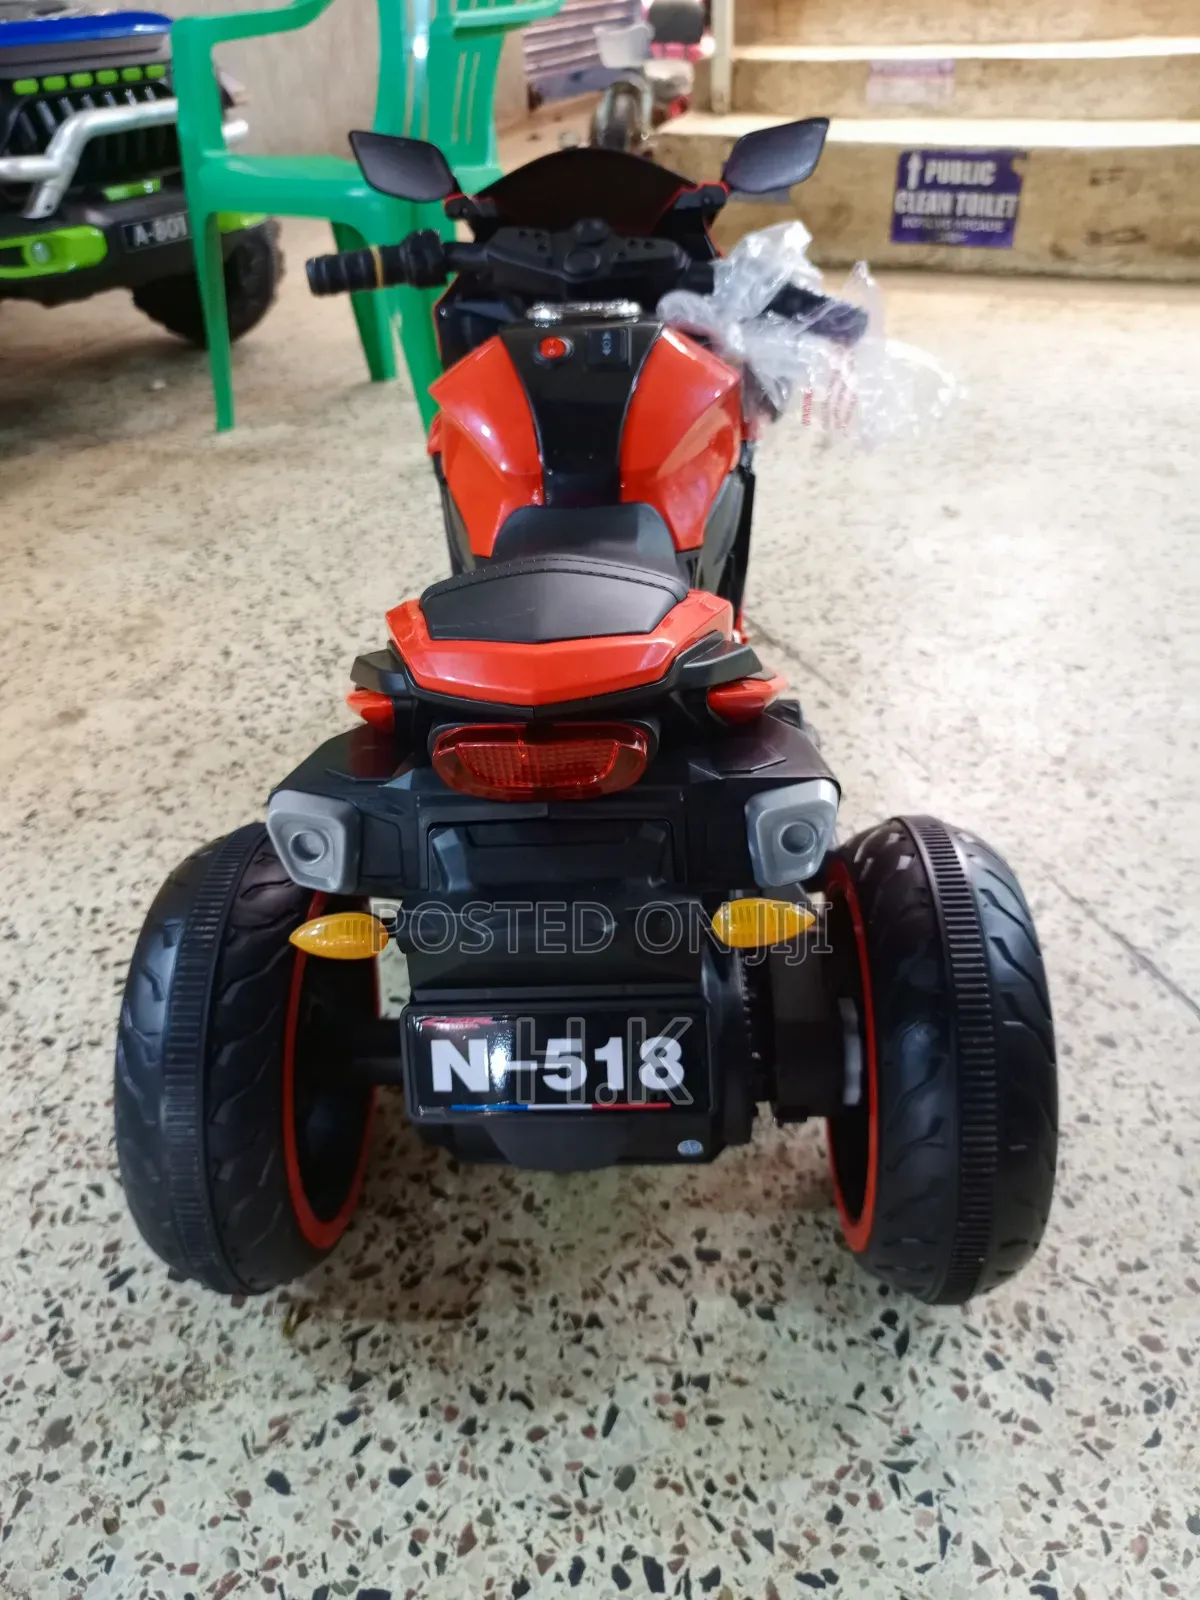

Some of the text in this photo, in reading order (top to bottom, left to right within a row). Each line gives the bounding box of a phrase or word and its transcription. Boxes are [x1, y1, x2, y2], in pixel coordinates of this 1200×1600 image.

[924, 159, 997, 186] PUBLIC
[894, 189, 1018, 219] CLEAN TOILET
